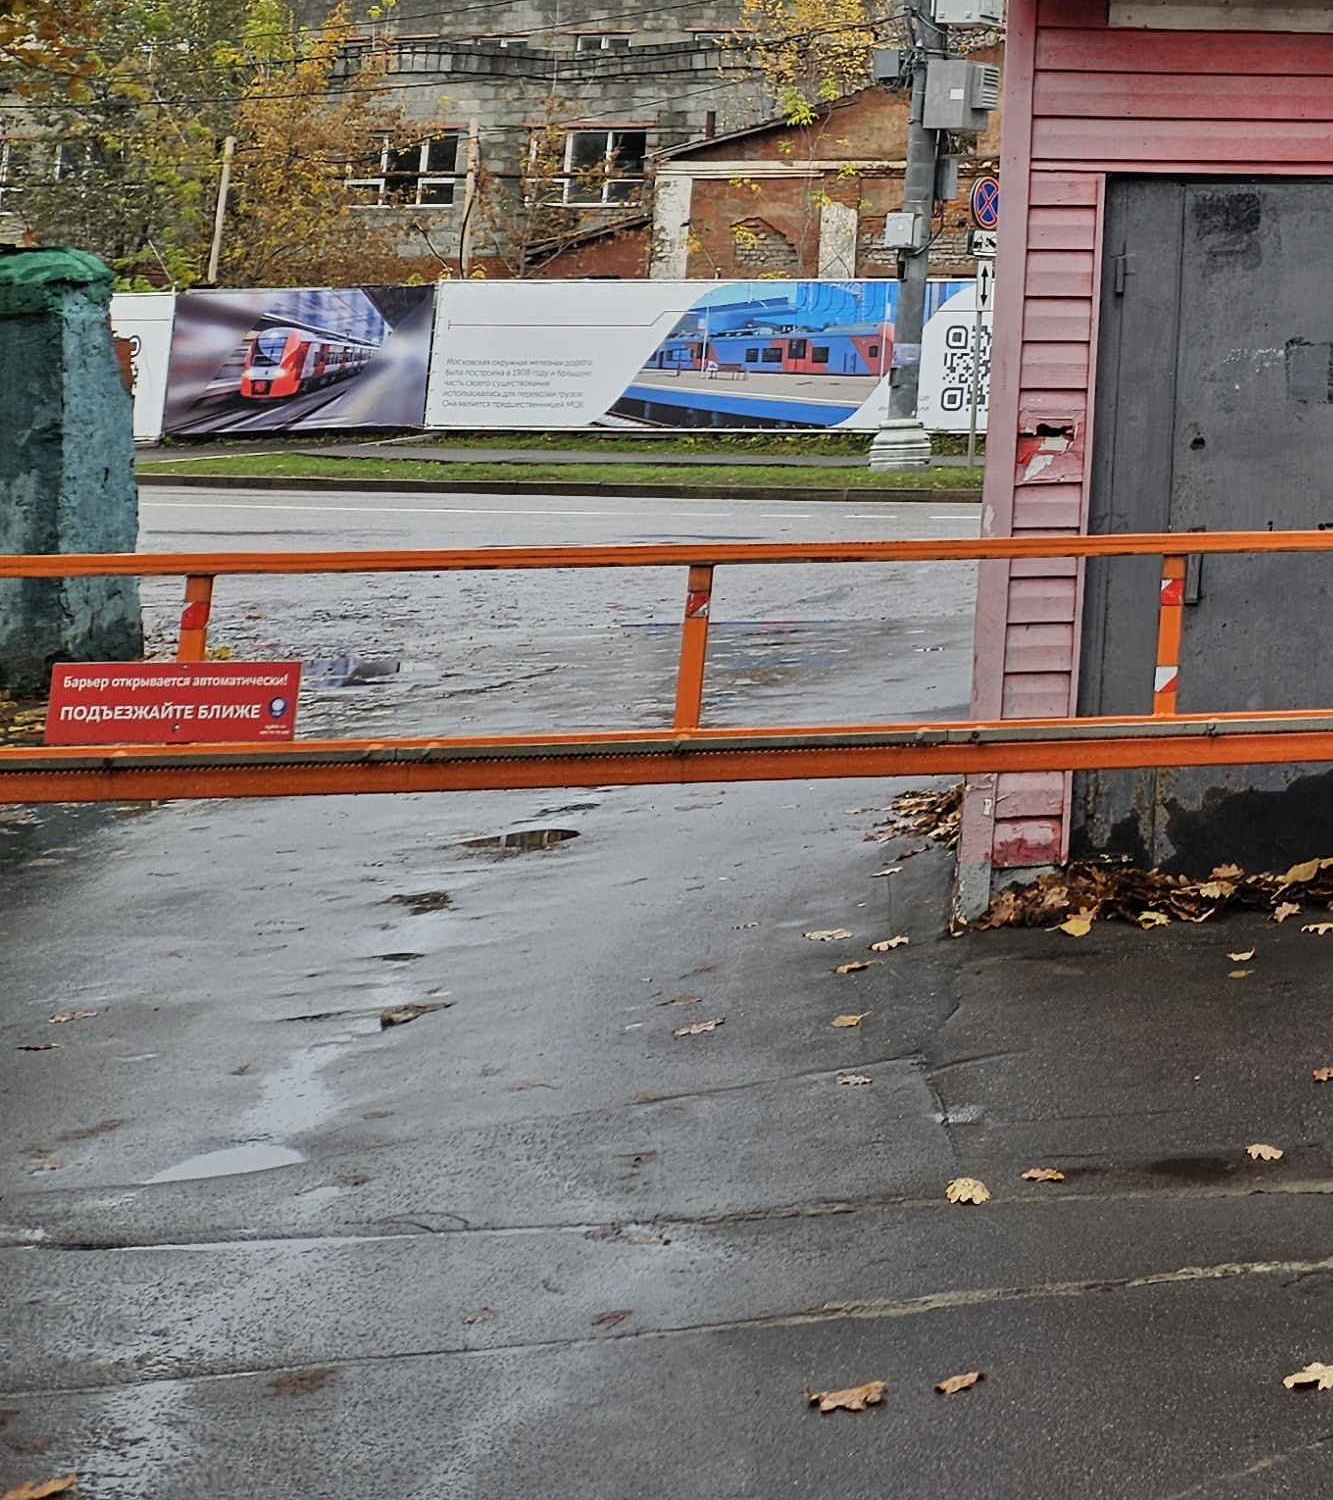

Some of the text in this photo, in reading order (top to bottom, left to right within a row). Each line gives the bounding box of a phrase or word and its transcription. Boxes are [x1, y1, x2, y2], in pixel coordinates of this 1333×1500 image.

[63, 672, 289, 692] Барьер открывается автоматически!
[60, 702, 262, 723] ПОДЪЕЗЖАЙТЕ БЛИЖЕ
